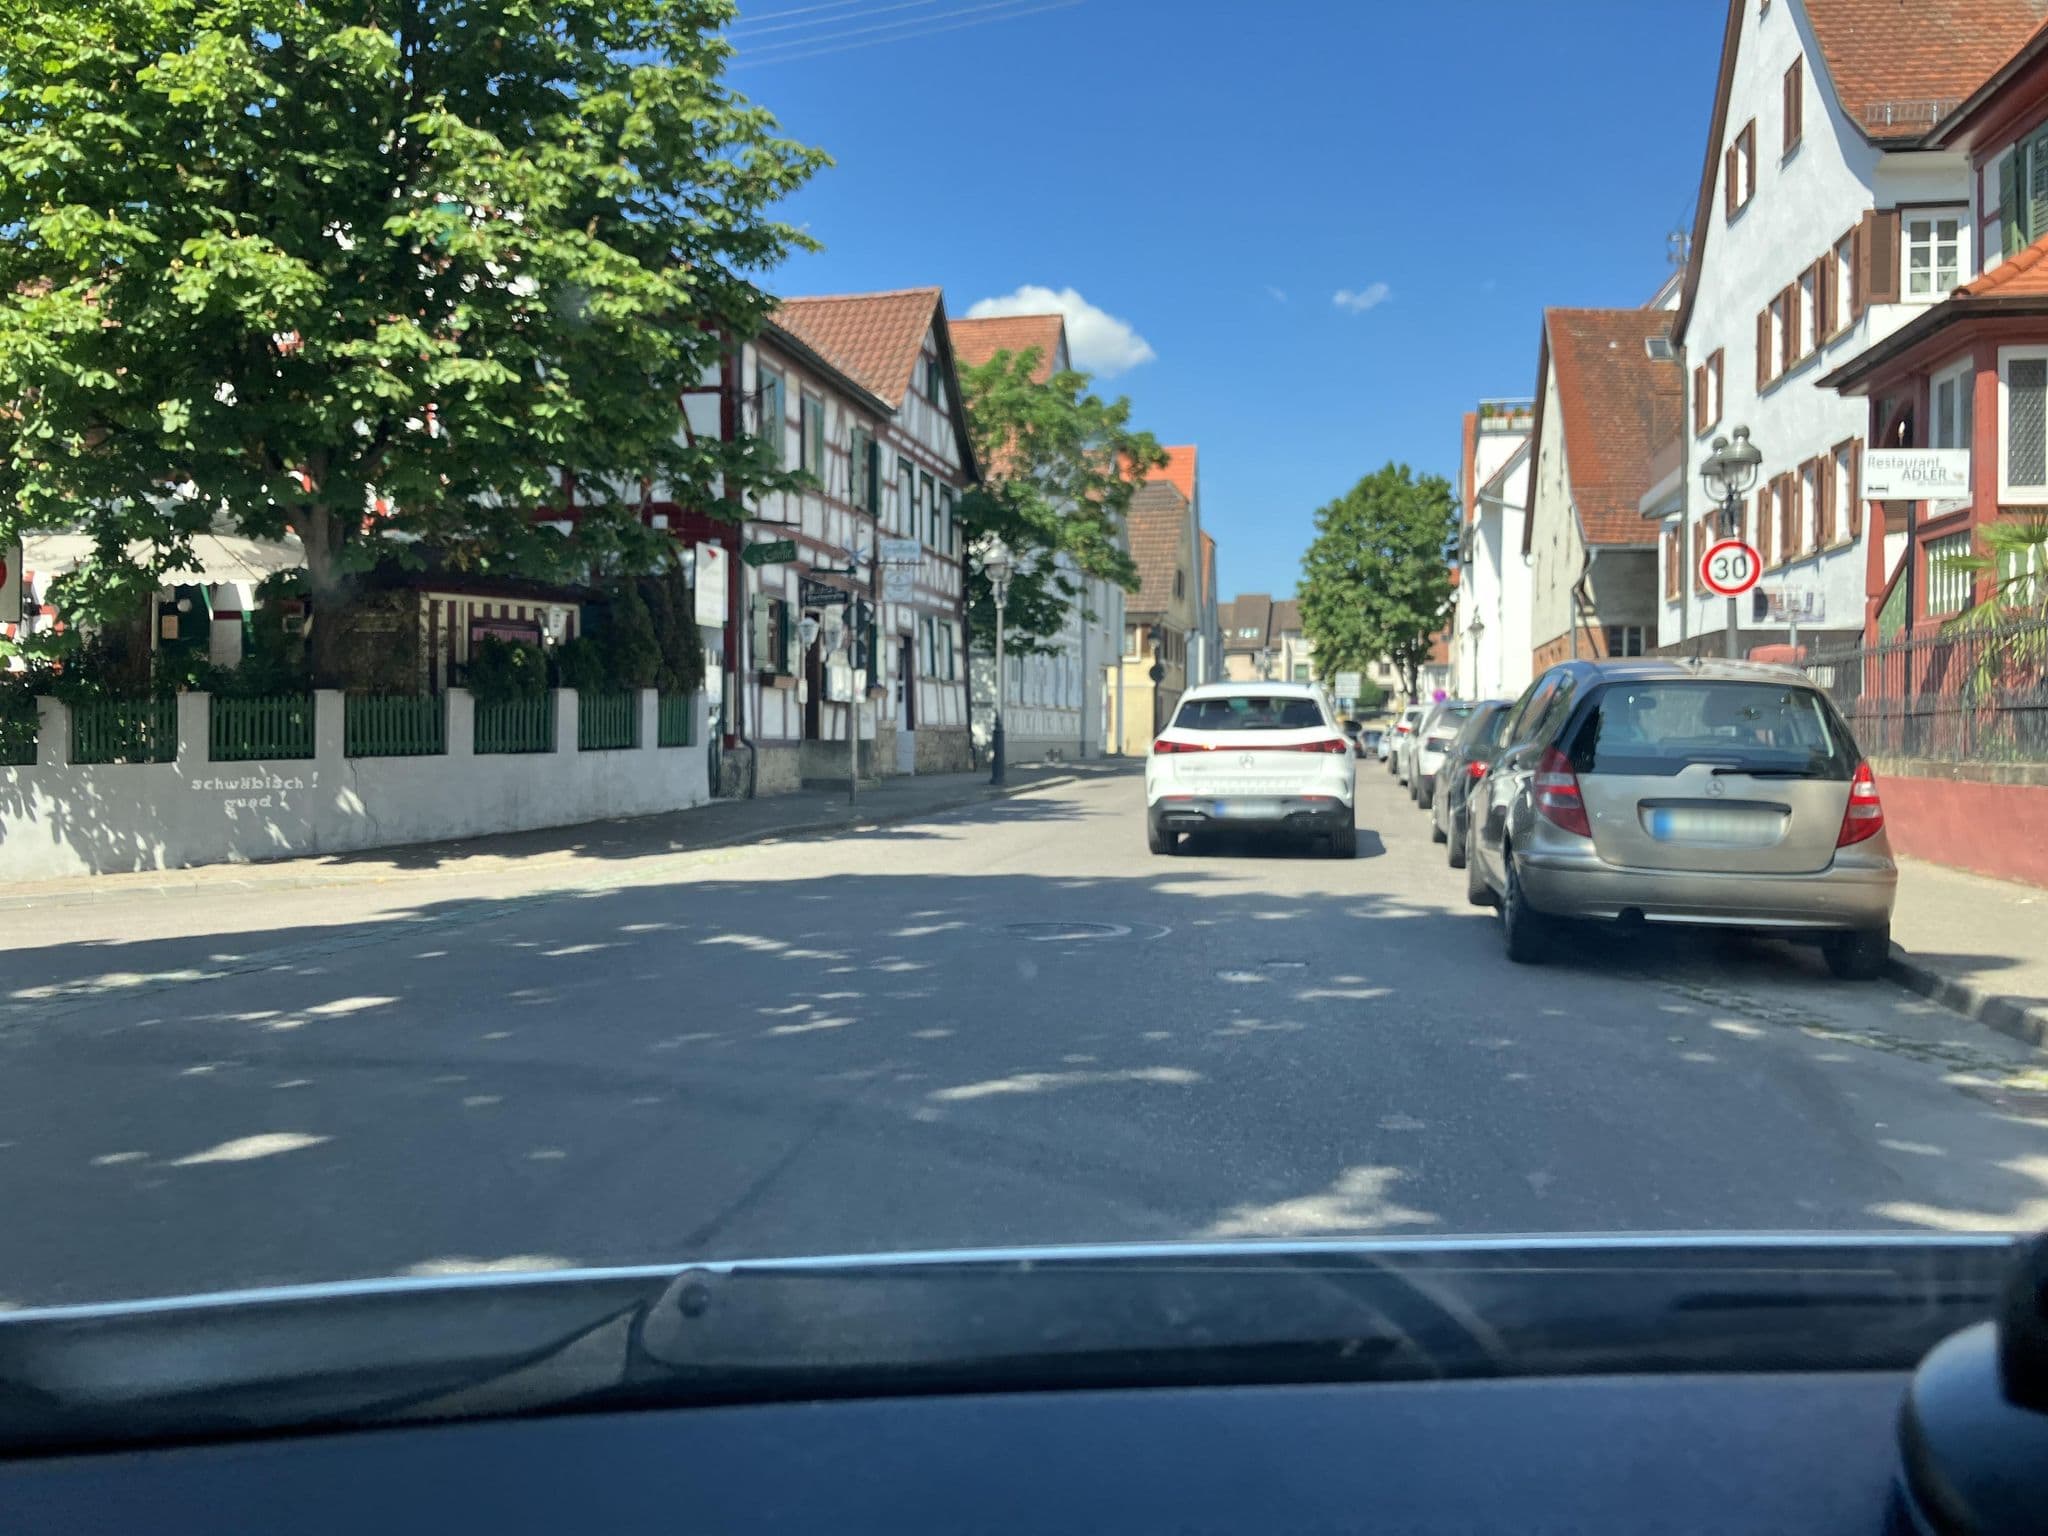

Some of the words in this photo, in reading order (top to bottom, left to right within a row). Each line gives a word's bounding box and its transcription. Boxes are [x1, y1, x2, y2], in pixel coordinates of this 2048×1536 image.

[1867, 455, 1941, 469] Restaurant
[1902, 469, 1947, 481] ADLER
[1713, 556, 1748, 580] 30
